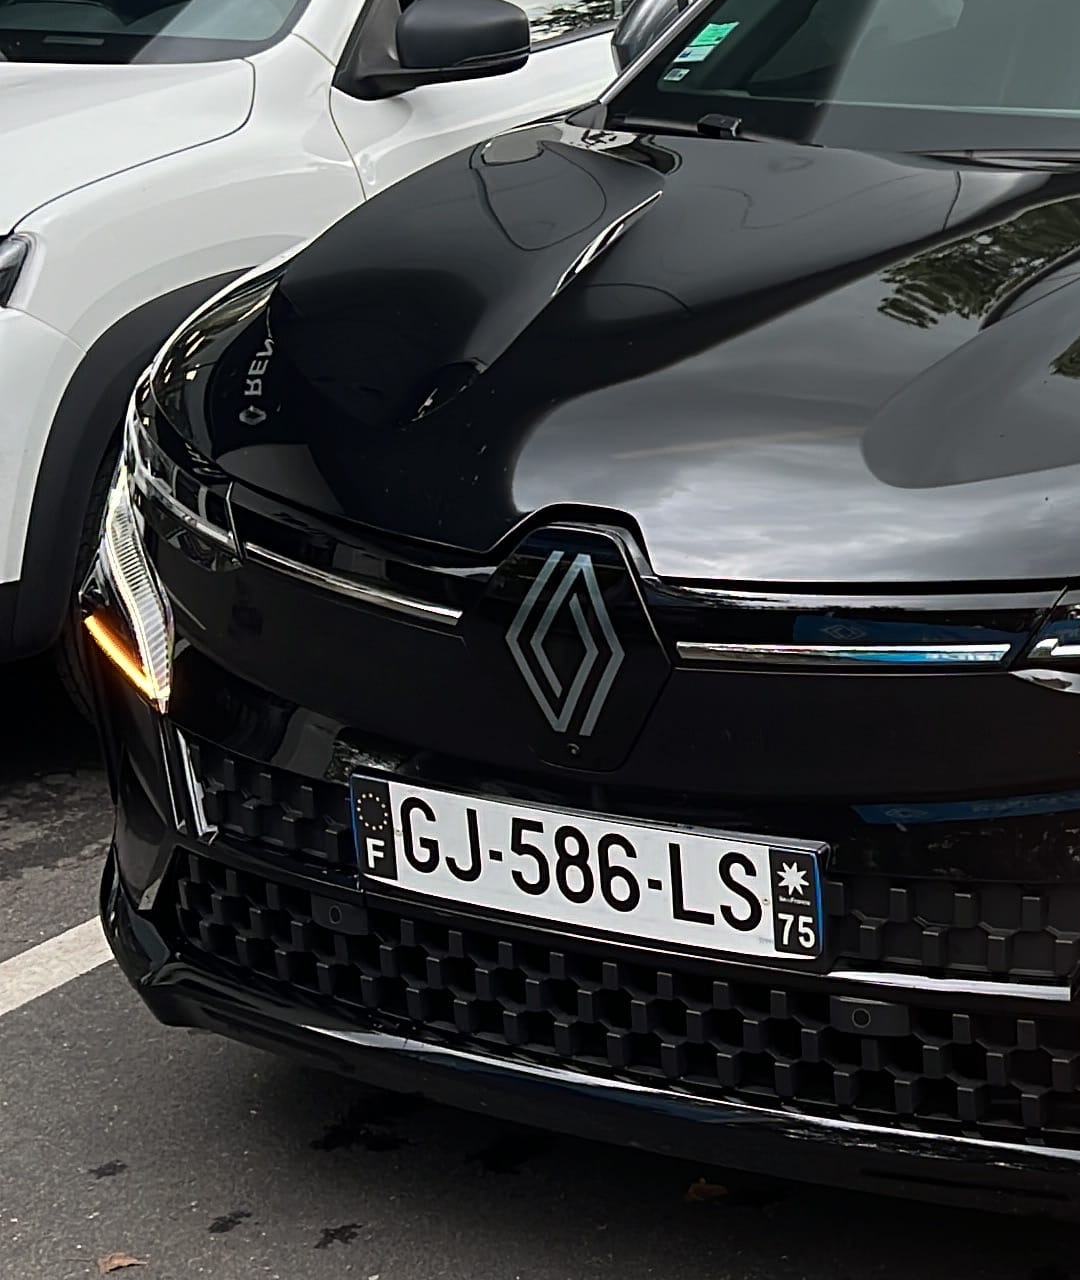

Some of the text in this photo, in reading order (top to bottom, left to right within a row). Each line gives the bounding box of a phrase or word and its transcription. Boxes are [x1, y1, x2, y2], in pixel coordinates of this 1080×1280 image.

[368, 838, 385, 869] F
[399, 796, 763, 931] GJ-586-LS
[778, 913, 815, 948] 75
